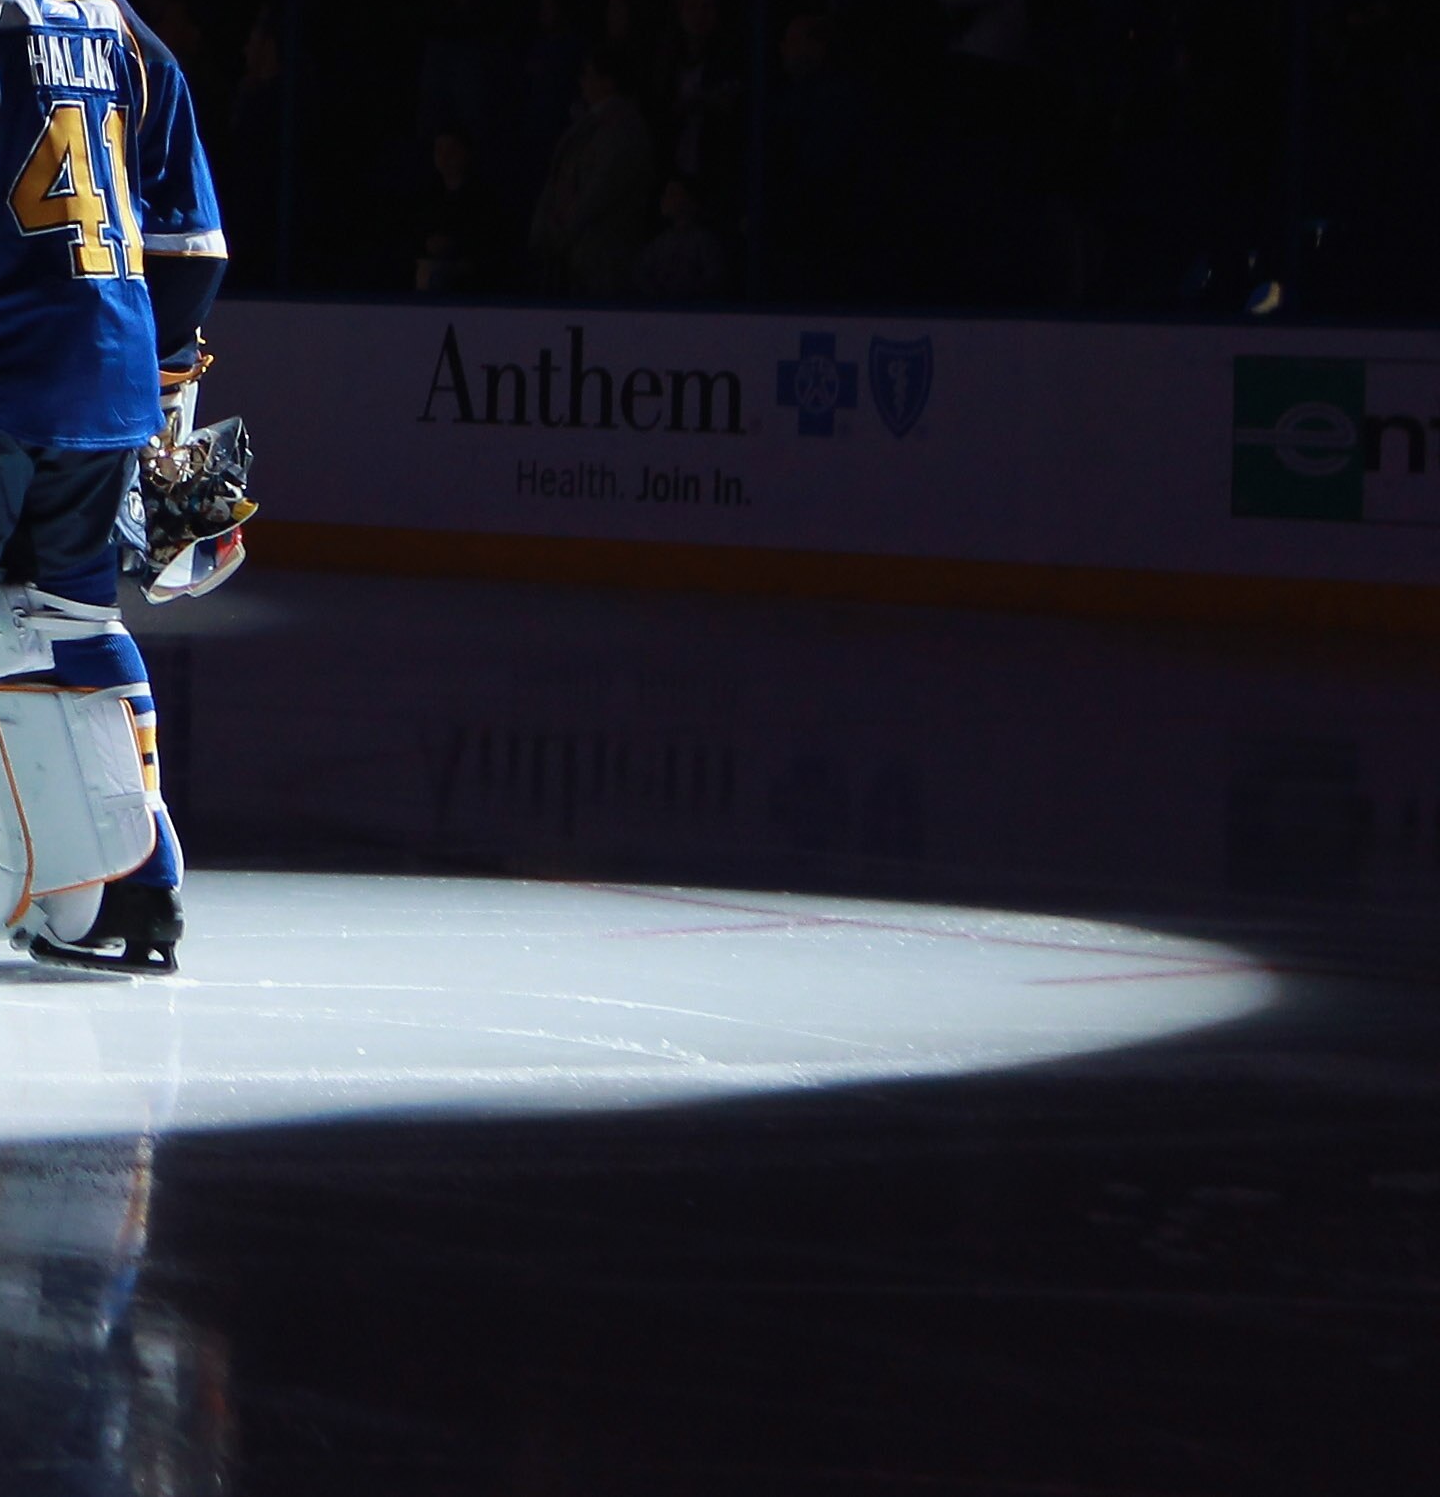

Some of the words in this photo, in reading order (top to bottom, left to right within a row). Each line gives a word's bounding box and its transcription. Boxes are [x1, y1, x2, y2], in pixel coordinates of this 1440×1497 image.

[27, 33, 117, 92] HALAK
[6, 100, 146, 280] 41
[416, 322, 747, 435] Anthem
[516, 460, 625, 501] Health.
[635, 464, 700, 504] Join
[713, 468, 753, 507] In.
